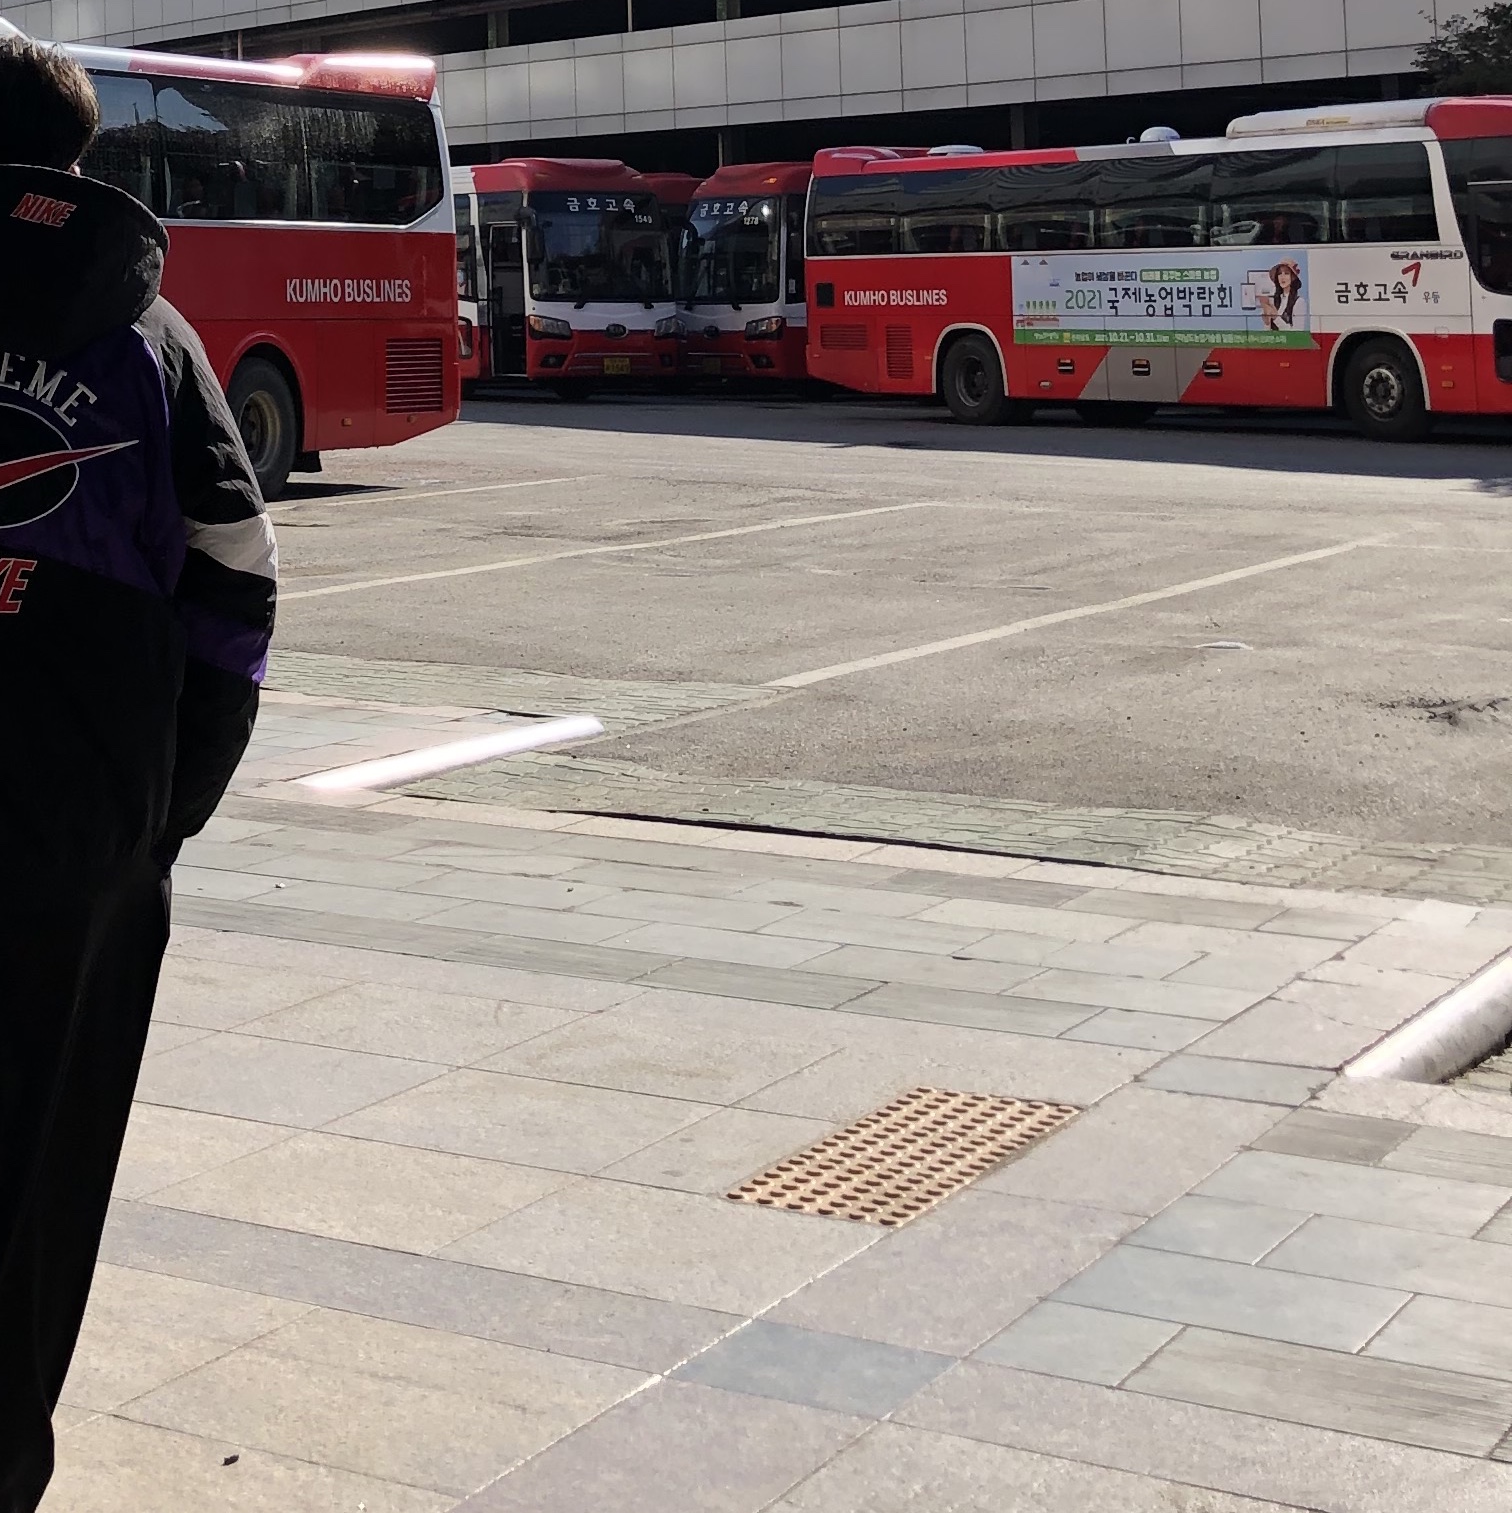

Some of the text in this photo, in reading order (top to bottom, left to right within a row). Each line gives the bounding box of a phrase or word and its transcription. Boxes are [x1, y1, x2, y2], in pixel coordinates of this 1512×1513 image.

[9, 192, 78, 228] NIKE
[566, 197, 636, 214] 금호고속
[699, 200, 749, 218] 금호고속
[285, 278, 412, 303] KUMHO BUSLINES
[844, 289, 948, 306] KUMHO BUSLINES
[1065, 283, 1234, 318] 2021 국제농업박람회
[1334, 281, 1409, 304] 금호고속
